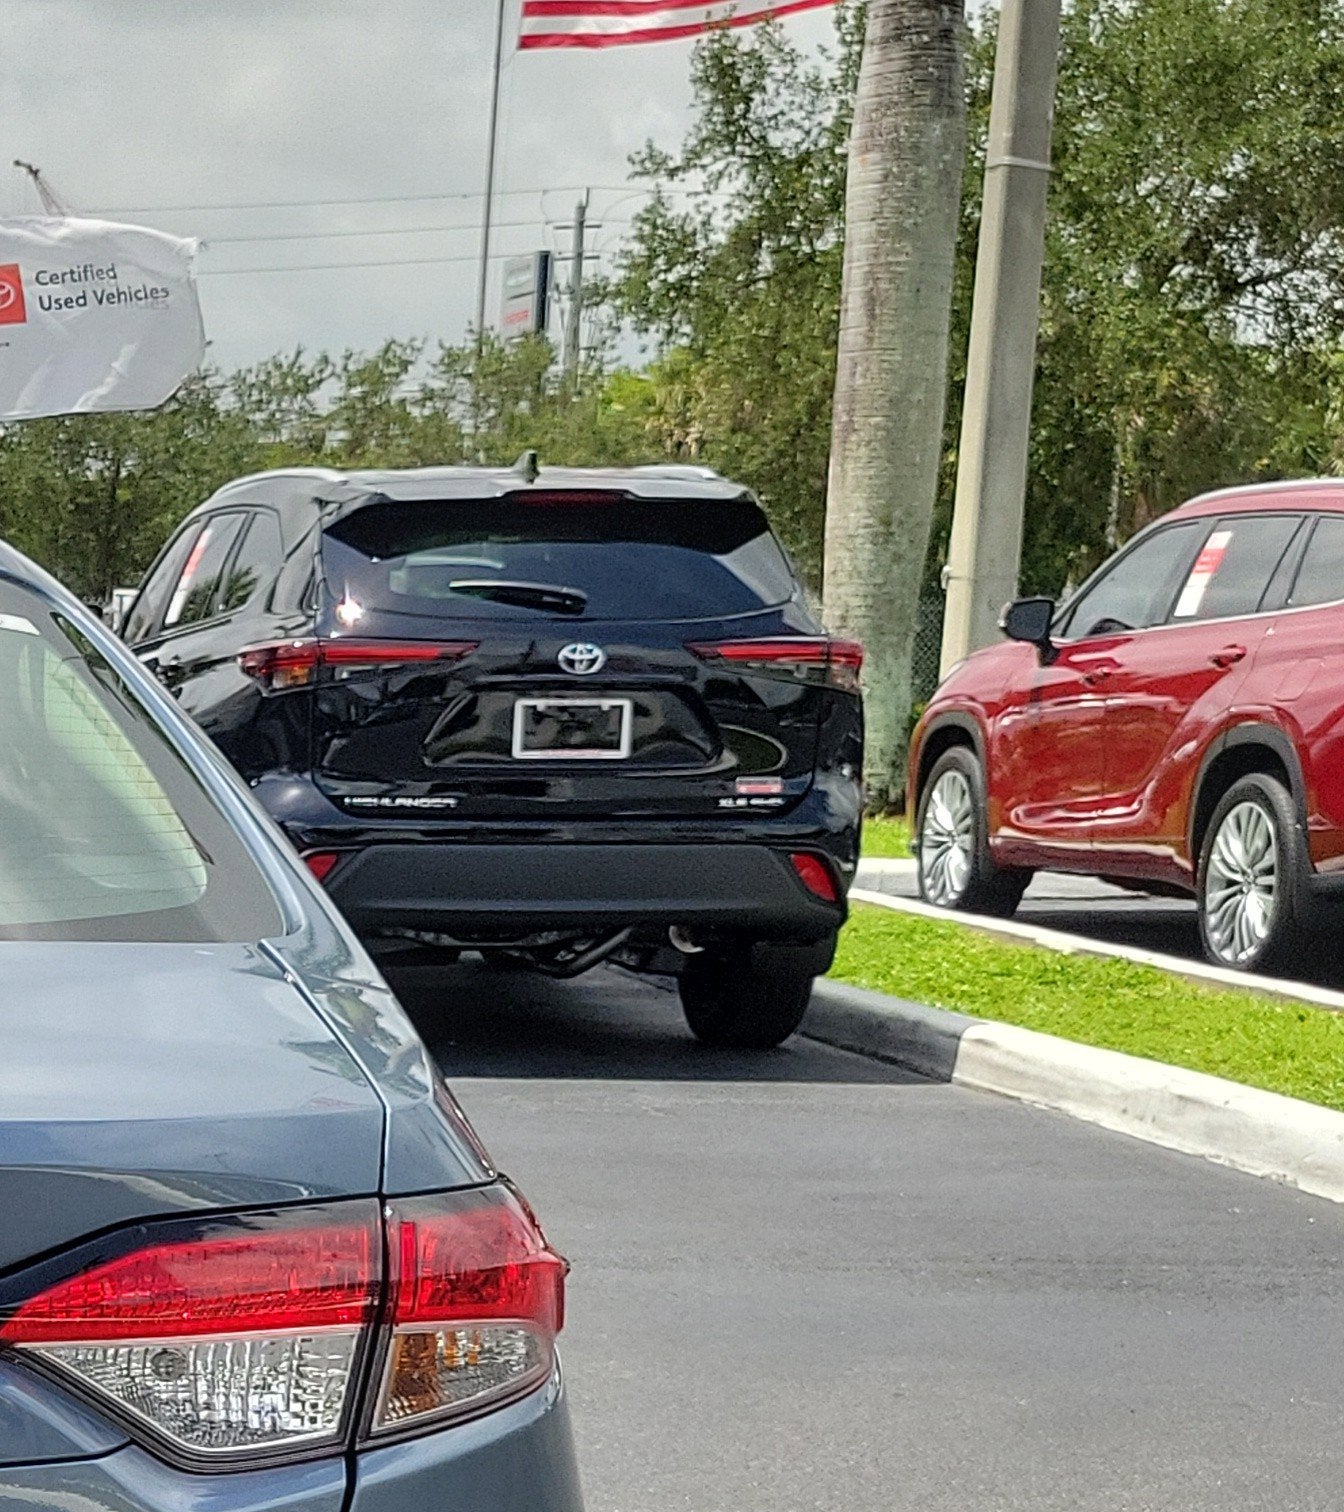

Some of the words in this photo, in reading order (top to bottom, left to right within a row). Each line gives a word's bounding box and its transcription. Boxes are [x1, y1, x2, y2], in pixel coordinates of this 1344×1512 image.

[35, 263, 117, 286] Certified
[39, 290, 87, 312] Used
[92, 284, 170, 306] Vehicles
